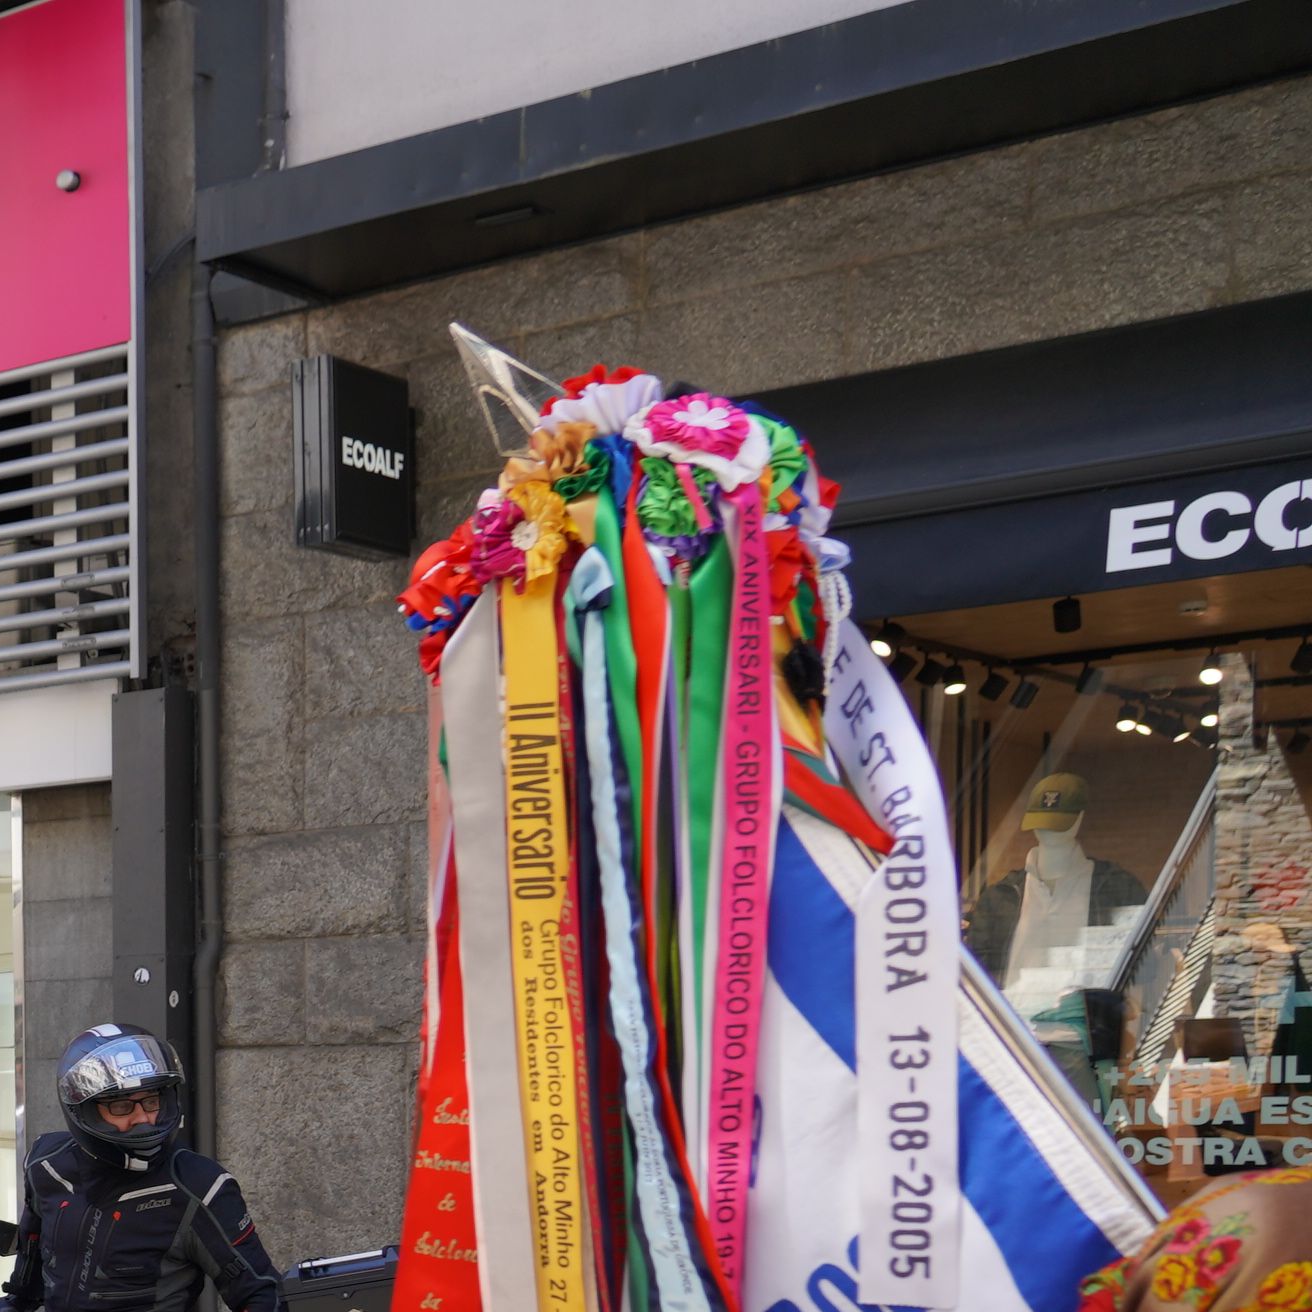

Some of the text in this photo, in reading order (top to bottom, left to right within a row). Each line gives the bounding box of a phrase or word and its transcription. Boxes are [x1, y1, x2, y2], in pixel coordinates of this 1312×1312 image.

[341, 436, 405, 480] ECOALF
[737, 554, 762, 716] ANIVERSARI
[508, 701, 568, 901] II Aniversario
[734, 741, 761, 837] GRUPO
[536, 918, 561, 991] Grupo
[726, 845, 757, 1015] FOLCLORICO
[543, 995, 566, 1107] Folclorico
[724, 1024, 747, 1060] DO
[1231, 1055, 1311, 1084] MIL
[521, 920, 551, 1268] dos Residentes em Andorra
[550, 1112, 571, 1141] do
[718, 1067, 745, 1133] ALTO
[551, 1147, 573, 1194] Alto
[715, 1142, 739, 1224] MINHO
[887, 1025, 934, 1281] 13-08-2005
[553, 1199, 576, 1269] Minho
